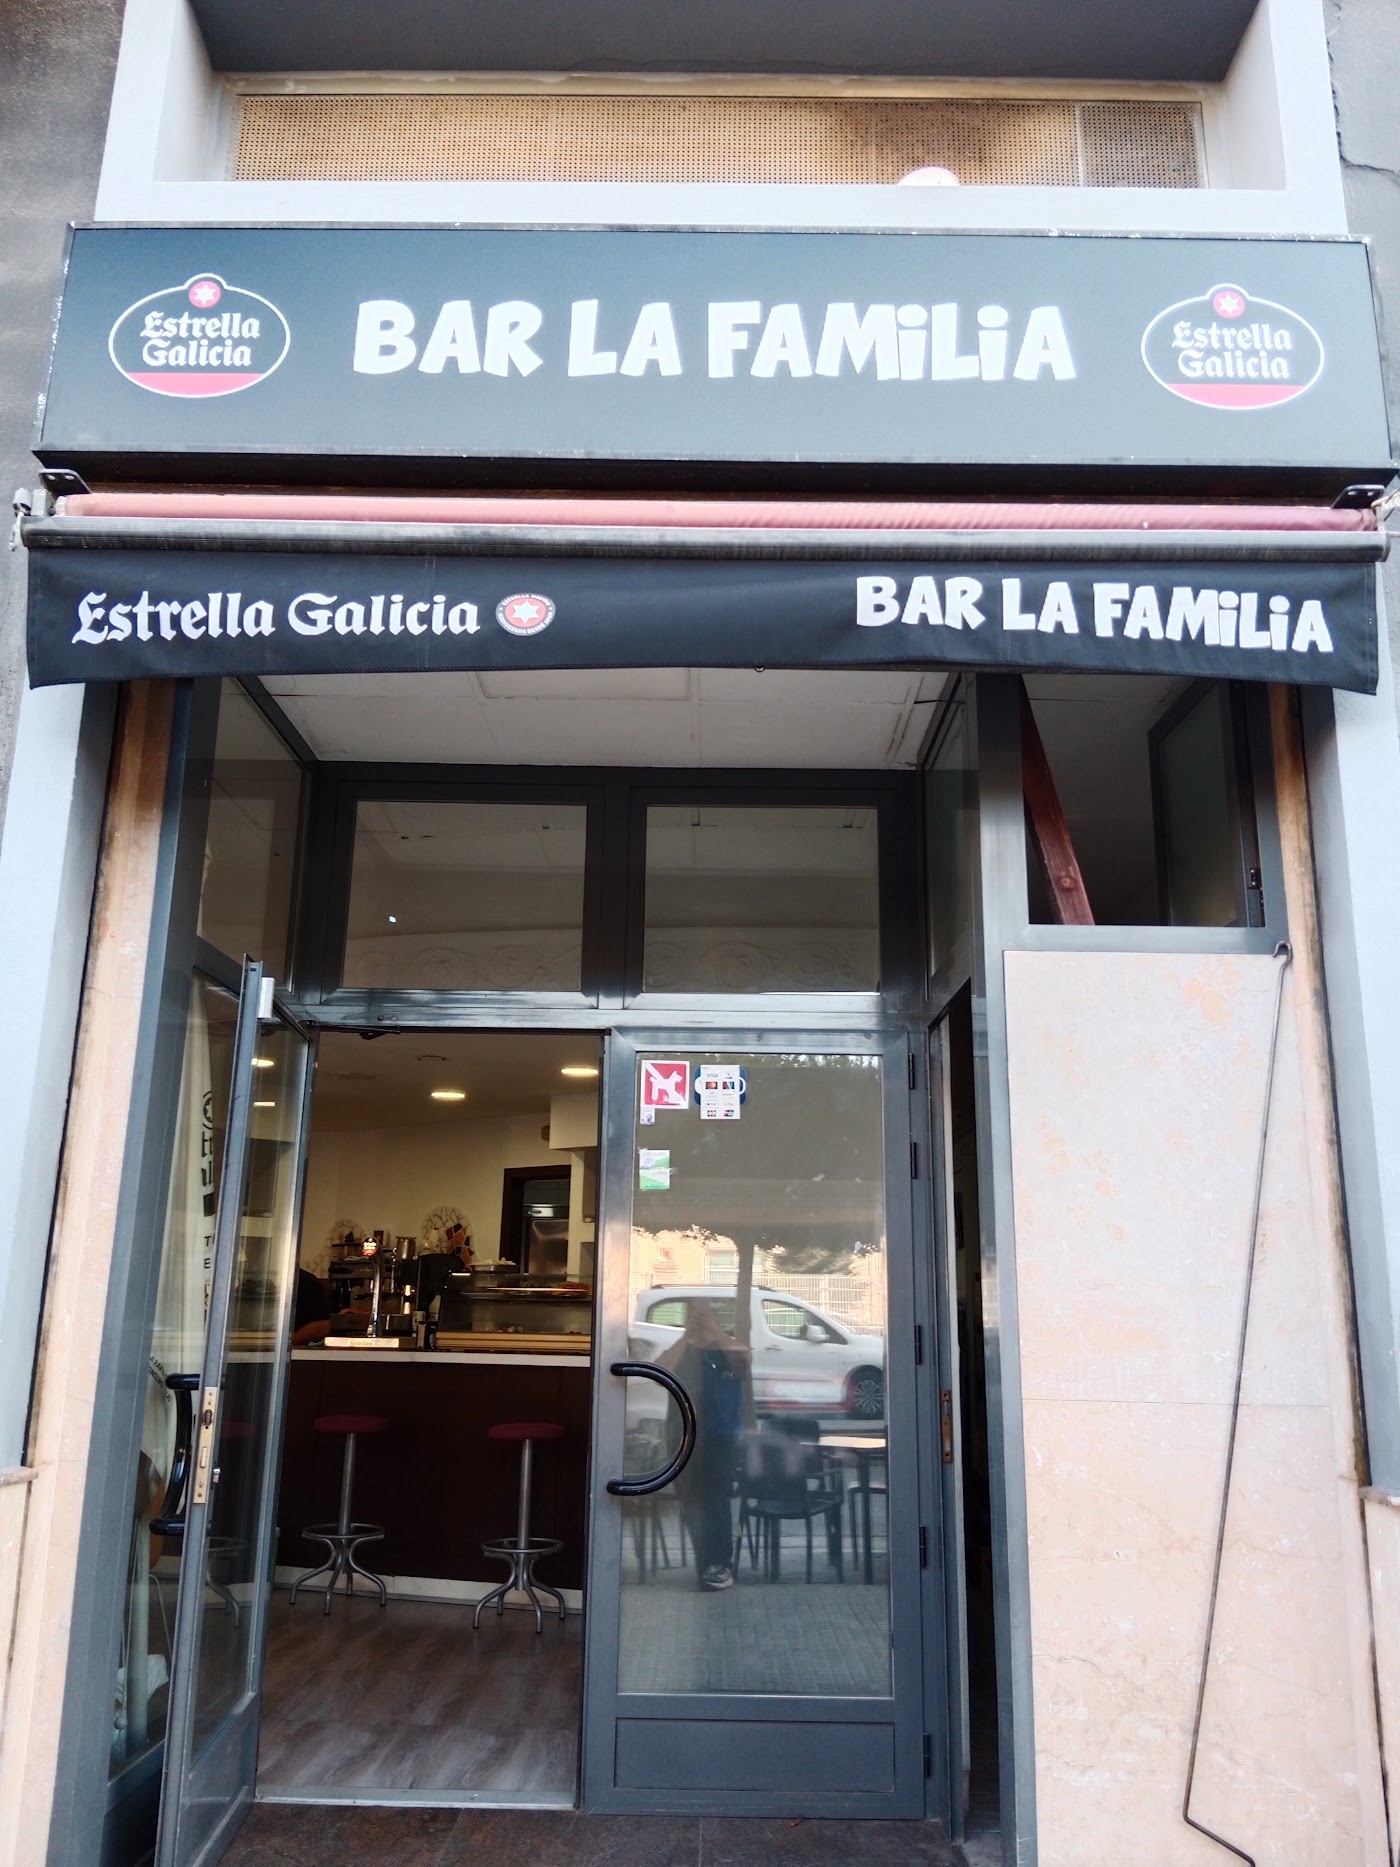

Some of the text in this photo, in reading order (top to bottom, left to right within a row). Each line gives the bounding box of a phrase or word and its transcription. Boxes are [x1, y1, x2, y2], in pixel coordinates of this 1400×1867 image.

[140, 310, 261, 340] Estrella
[352, 299, 544, 378] BAR
[567, 298, 683, 378] LA
[1171, 319, 1293, 352] Estrella
[142, 336, 252, 367] Galicia
[1177, 347, 1291, 380] Galicia
[71, 590, 276, 645] Estrella
[287, 592, 481, 636] Galicia
[856, 575, 986, 630] BAR
[1001, 577, 1080, 634] LA
